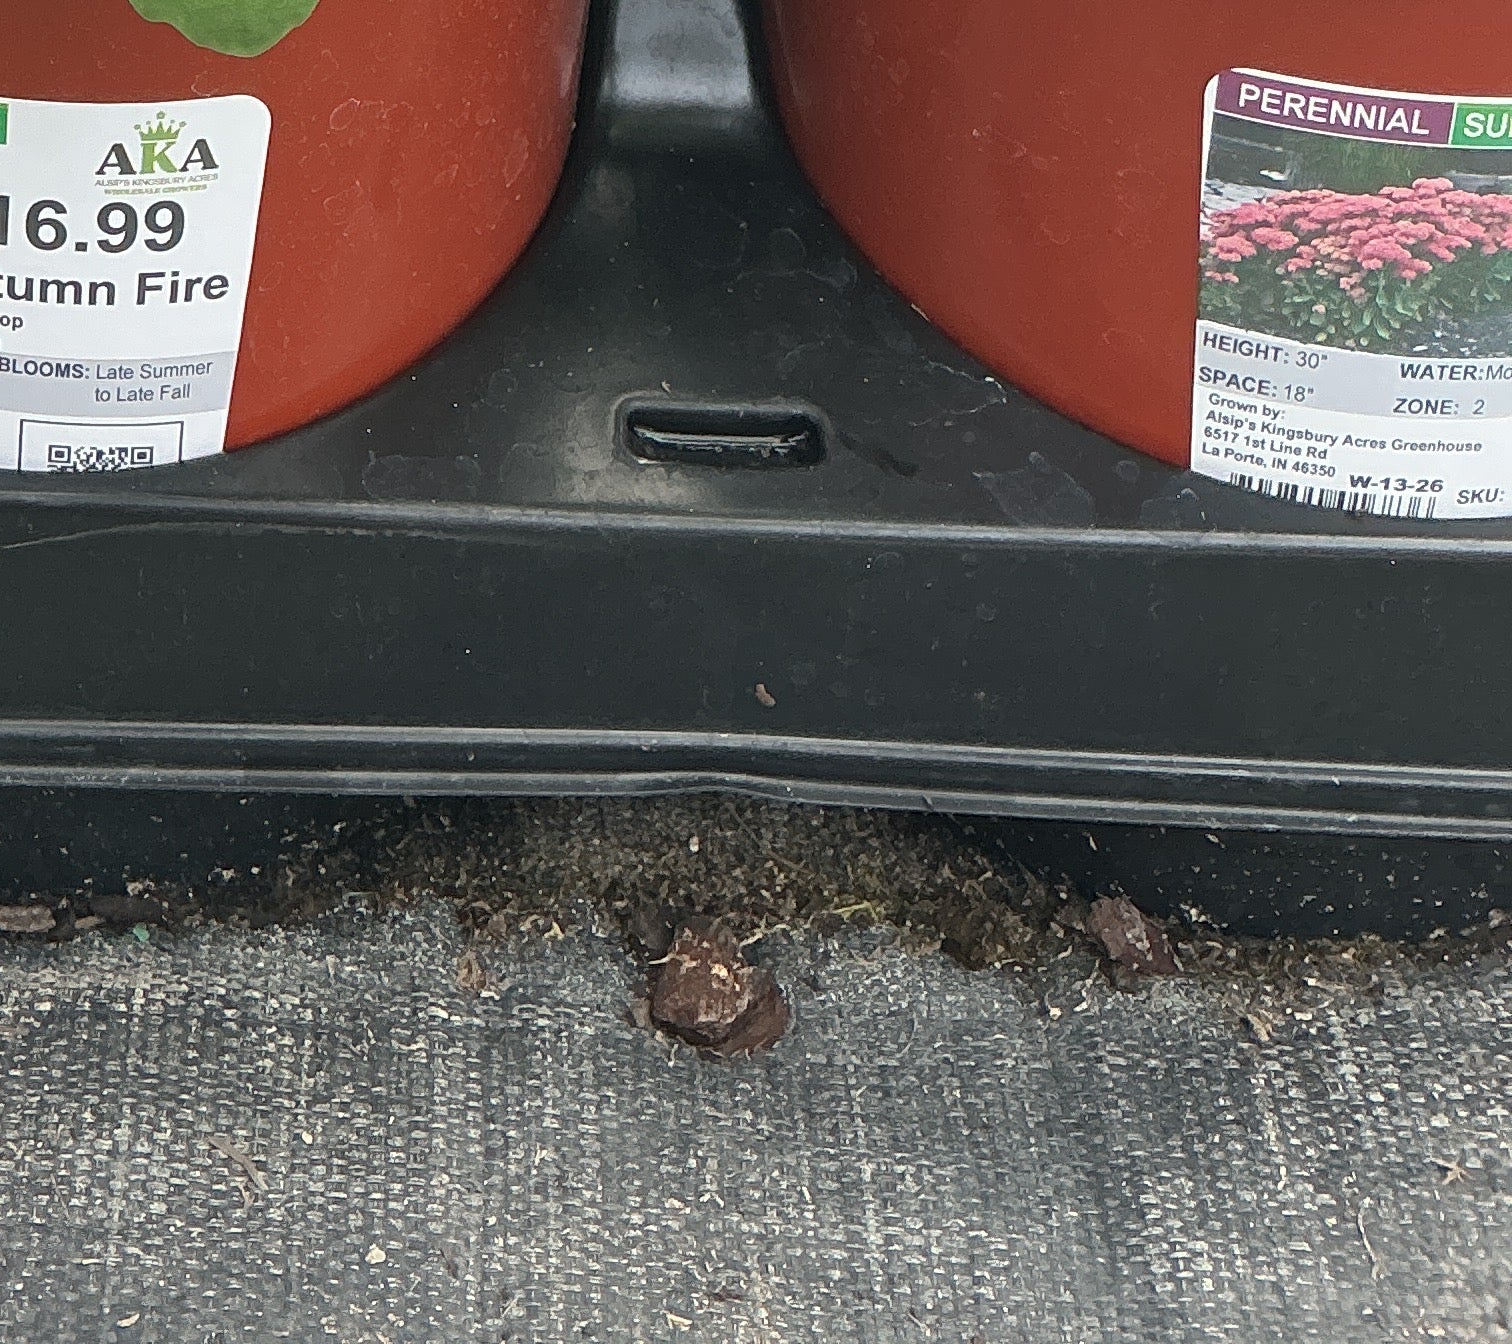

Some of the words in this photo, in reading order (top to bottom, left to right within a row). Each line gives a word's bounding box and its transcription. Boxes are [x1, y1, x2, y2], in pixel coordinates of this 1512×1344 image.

[1238, 82, 1430, 137] PERENNIAL
[95, 139, 219, 175] AKA
[136, 270, 229, 305] Fire
[1203, 331, 1289, 364] HEIGHT:
[1295, 351, 1328, 369] 30"
[96, 364, 134, 380] Late
[139, 361, 213, 379] Summer
[1198, 366, 1277, 397] SPACE:
[1284, 384, 1315, 402] 18"
[95, 387, 111, 402] to
[117, 386, 154, 402] Late
[160, 383, 191, 400] Fall
[1208, 393, 1257, 415] Grown
[1263, 404, 1285, 420] by:
[1393, 397, 1459, 415] ZONE:
[1472, 399, 1485, 415] 2
[1204, 426, 1240, 444] 6517
[1244, 435, 1267, 450] 1st
[1271, 440, 1302, 455] Line
[1307, 446, 1328, 460] Rd
[1205, 410, 1256, 431] Alsip's
[1260, 422, 1338, 446] Kingsbury
[1342, 435, 1386, 450] Acres
[1391, 439, 1483, 452] Greenhouse
[1202, 442, 1220, 457] La
[1224, 448, 1267, 468] Porte,
[1271, 457, 1287, 470] IN
[1292, 462, 1336, 477] 46350
[1349, 474, 1444, 492] W-13-26
[1456, 487, 1505, 505] SKU:
